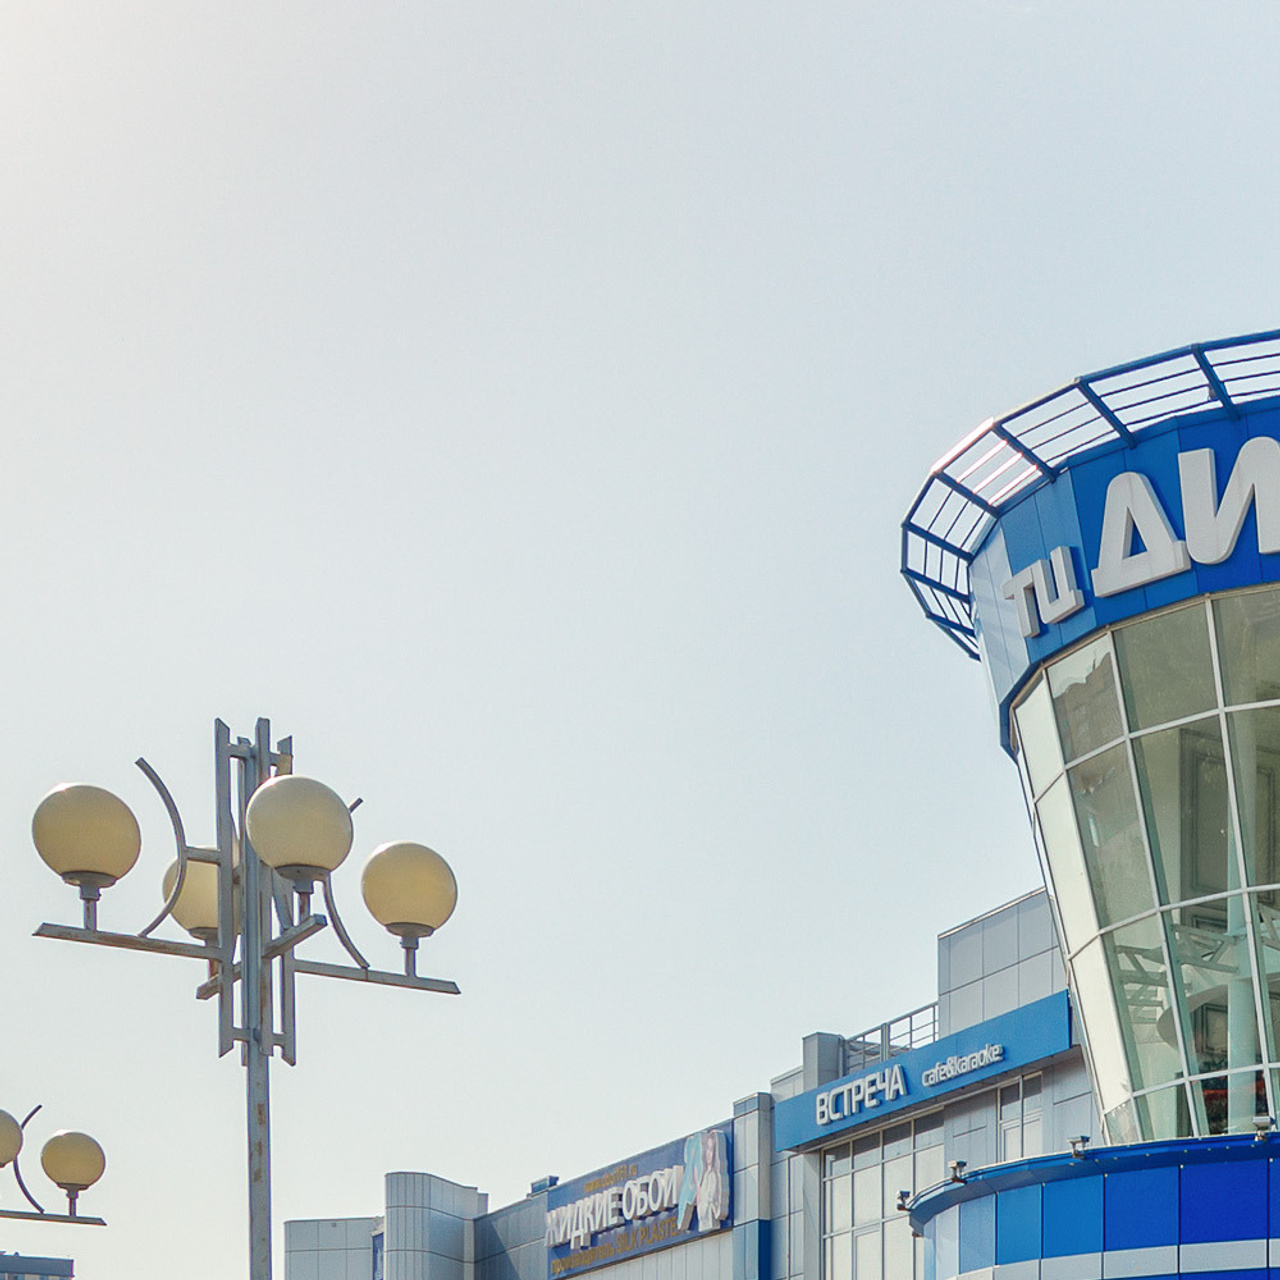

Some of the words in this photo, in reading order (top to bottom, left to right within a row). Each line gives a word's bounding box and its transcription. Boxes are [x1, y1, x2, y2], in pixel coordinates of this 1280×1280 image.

[1003, 545, 1085, 638] ТЦ
[816, 1064, 908, 1125] ВСТРЕЧА
[922, 1043, 1005, 1087] cafe&karaoke
[621, 1165, 684, 1220] ОБОИ
